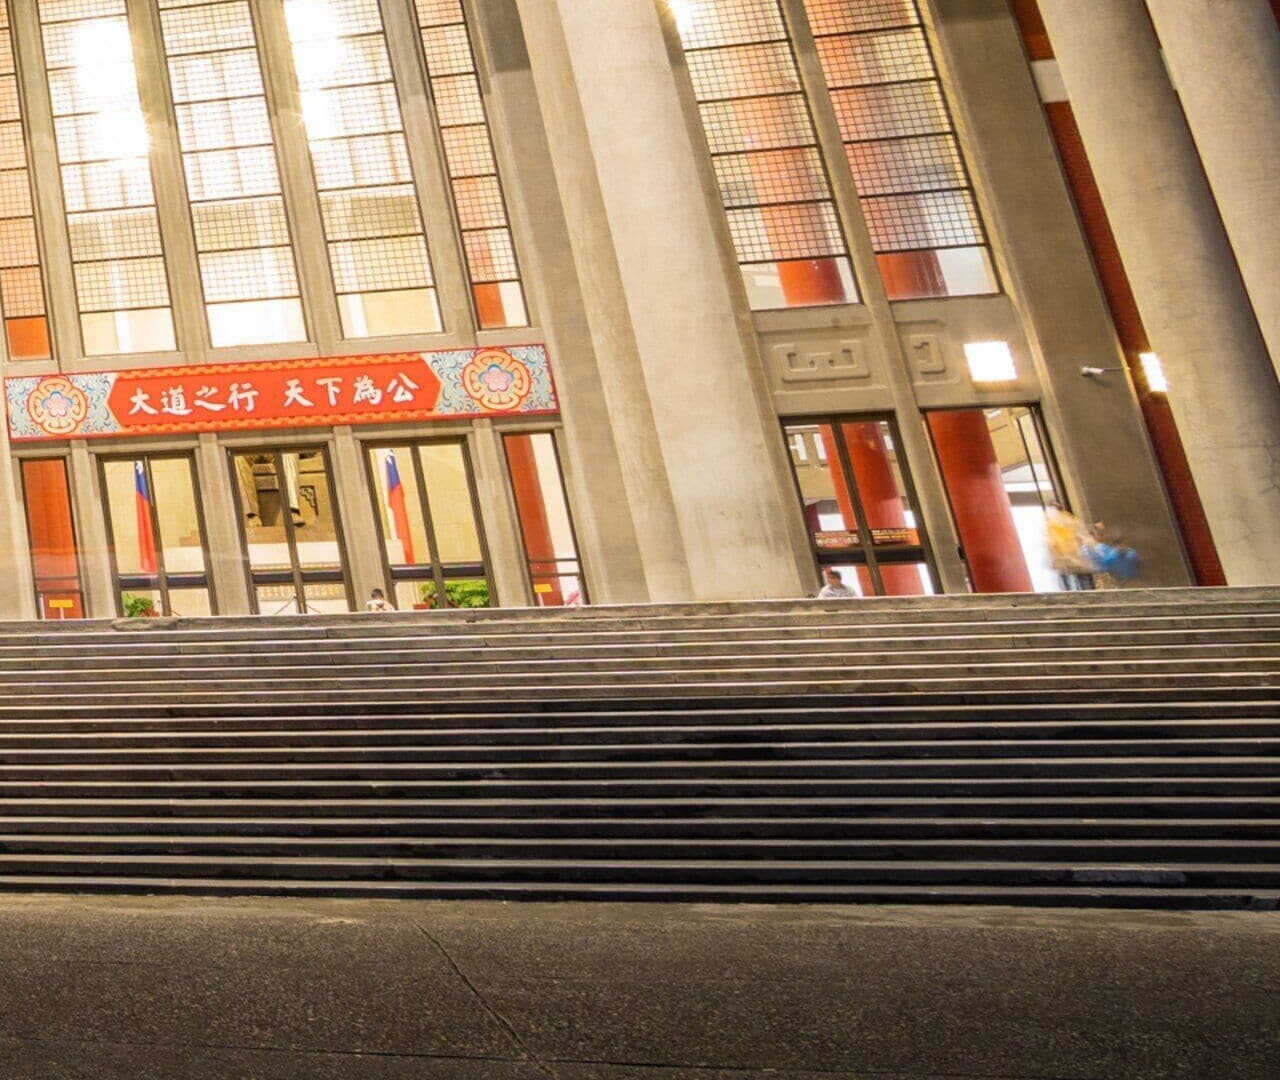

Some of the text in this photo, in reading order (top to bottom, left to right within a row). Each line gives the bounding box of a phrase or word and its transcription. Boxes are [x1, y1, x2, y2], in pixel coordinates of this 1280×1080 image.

[128, 372, 420, 416] 大道之行 天下為公
